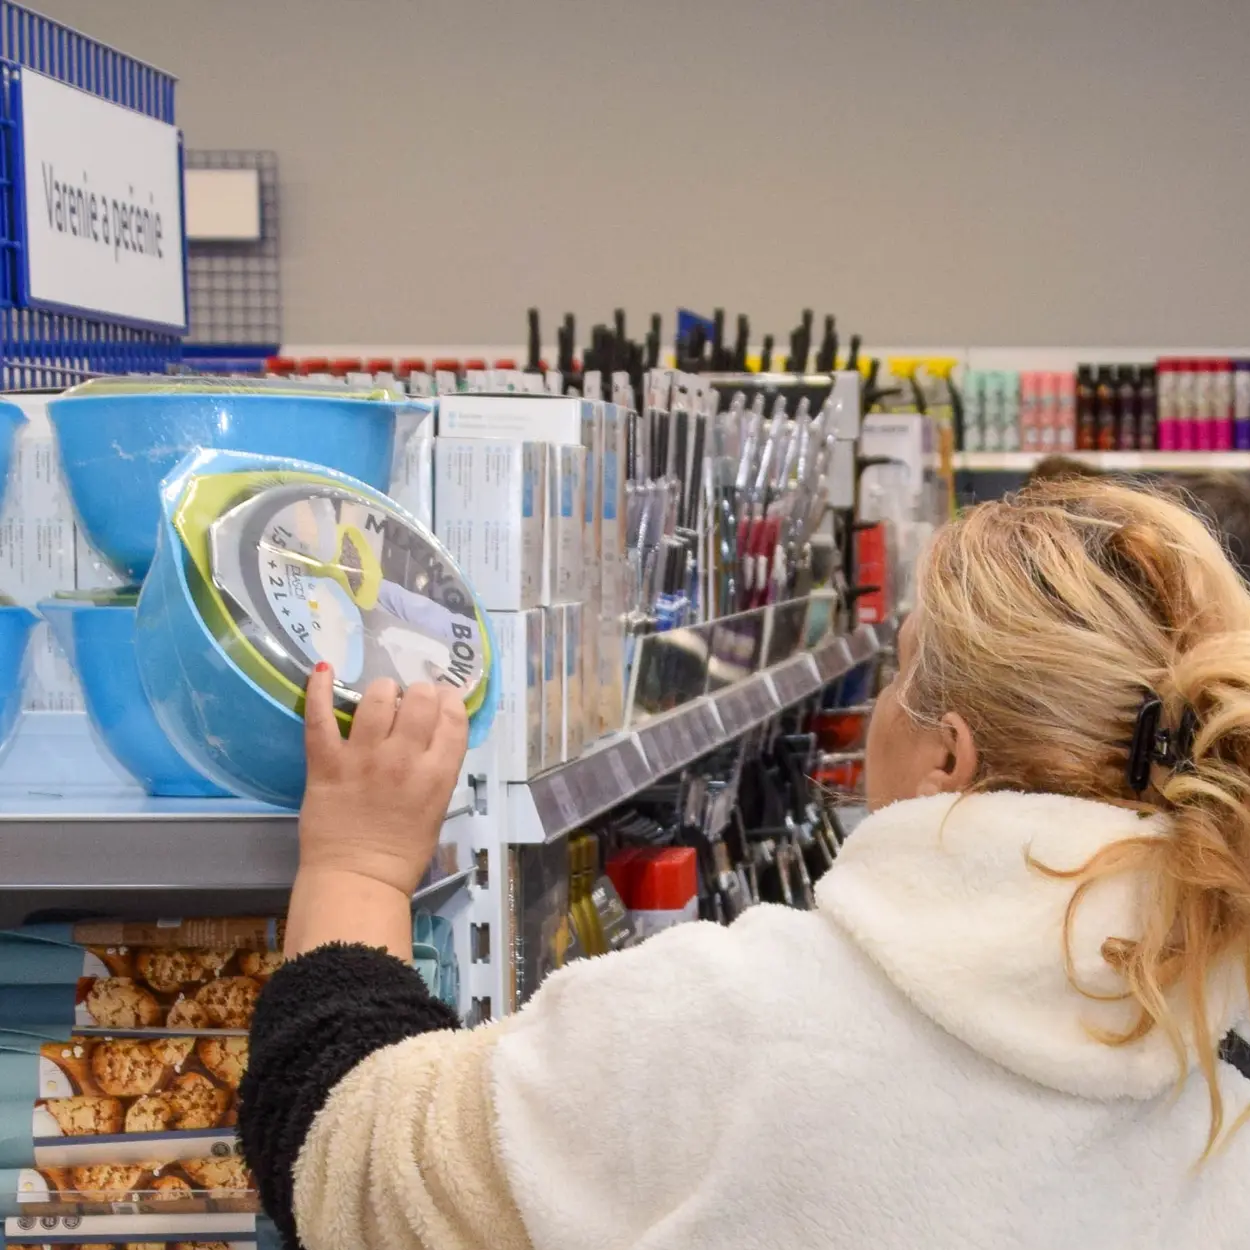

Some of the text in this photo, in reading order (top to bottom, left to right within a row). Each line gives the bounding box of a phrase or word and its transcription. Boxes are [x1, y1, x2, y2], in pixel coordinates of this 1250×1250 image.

[41, 160, 162, 263] Varenie a pečenie
[437, 622, 476, 689] BOWL
